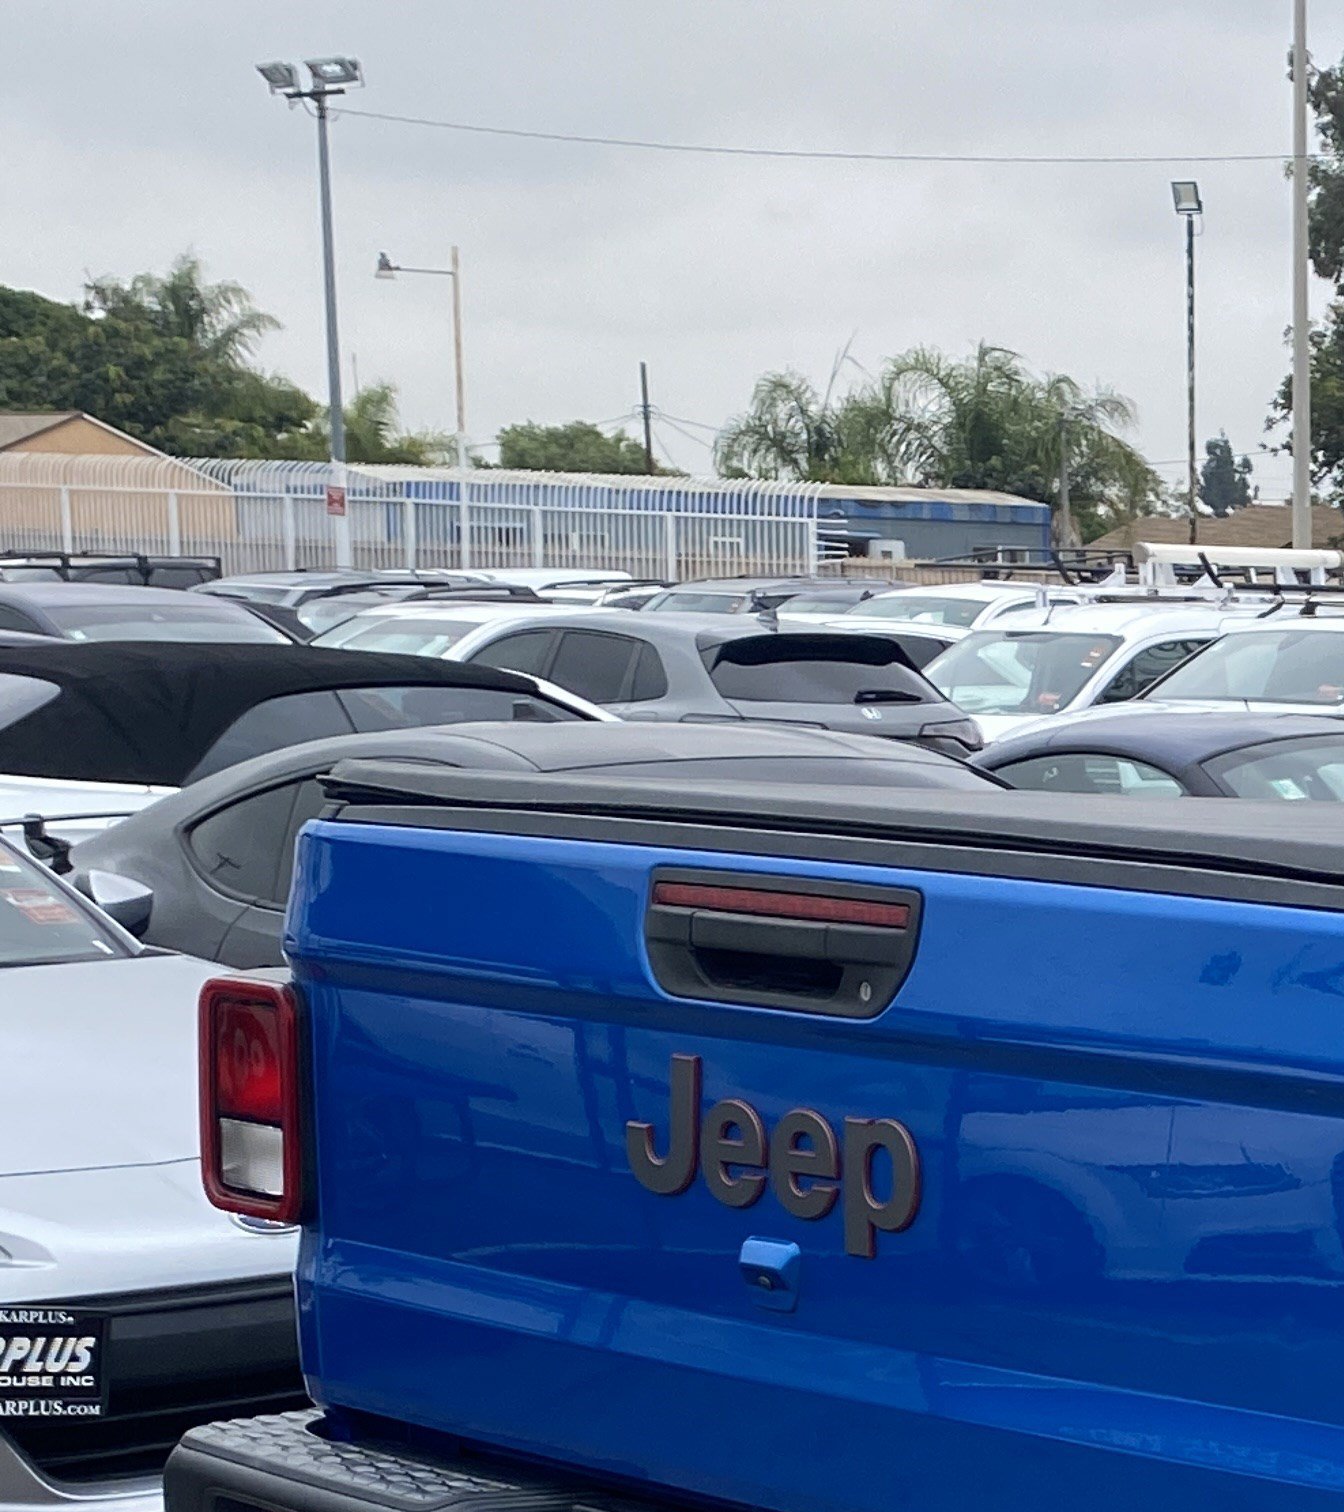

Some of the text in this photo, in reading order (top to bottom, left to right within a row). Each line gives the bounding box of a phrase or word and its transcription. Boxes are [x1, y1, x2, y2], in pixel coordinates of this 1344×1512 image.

[626, 1052, 921, 1258] Jeep
[0, 1336, 97, 1373] PLUS
[60, 1375, 95, 1387] INC
